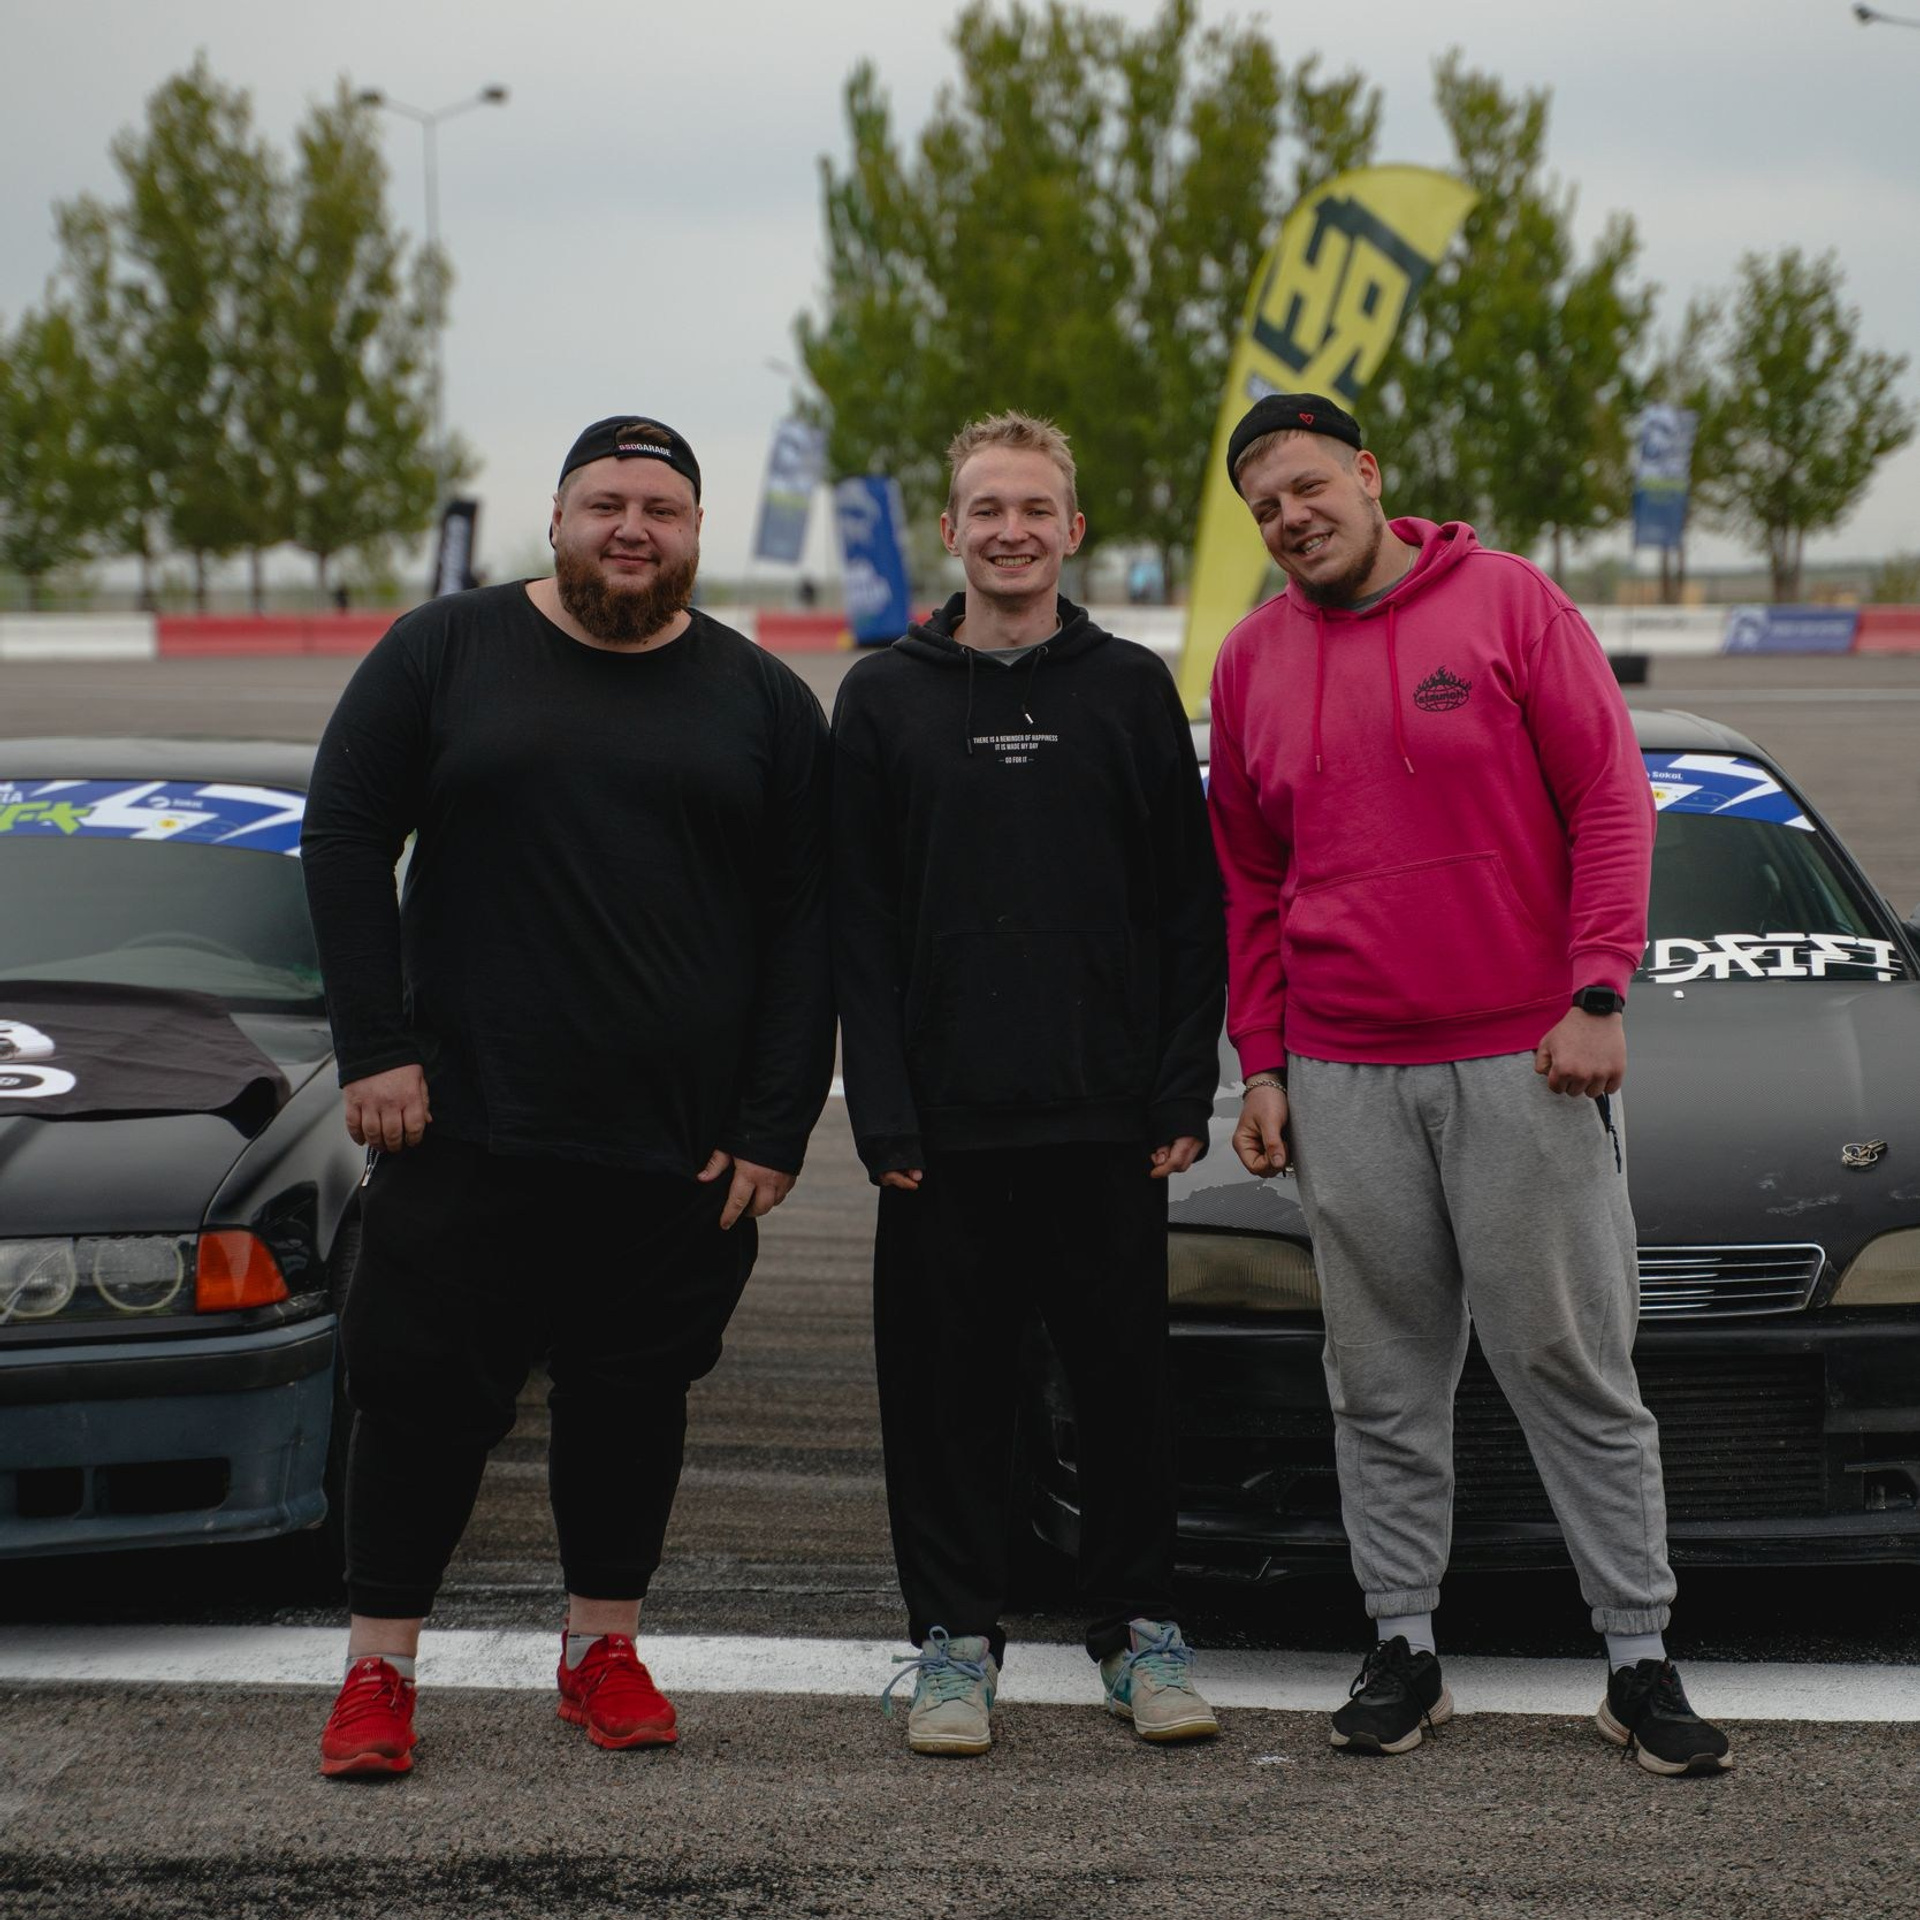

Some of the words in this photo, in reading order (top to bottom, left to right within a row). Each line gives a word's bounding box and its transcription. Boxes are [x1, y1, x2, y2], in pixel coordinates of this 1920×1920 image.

[973, 736, 989, 744] THERE
[1031, 734, 1058, 742] HAPPINESS
[995, 743, 1000, 751] IT
[1650, 932, 1901, 984] DRIFT
